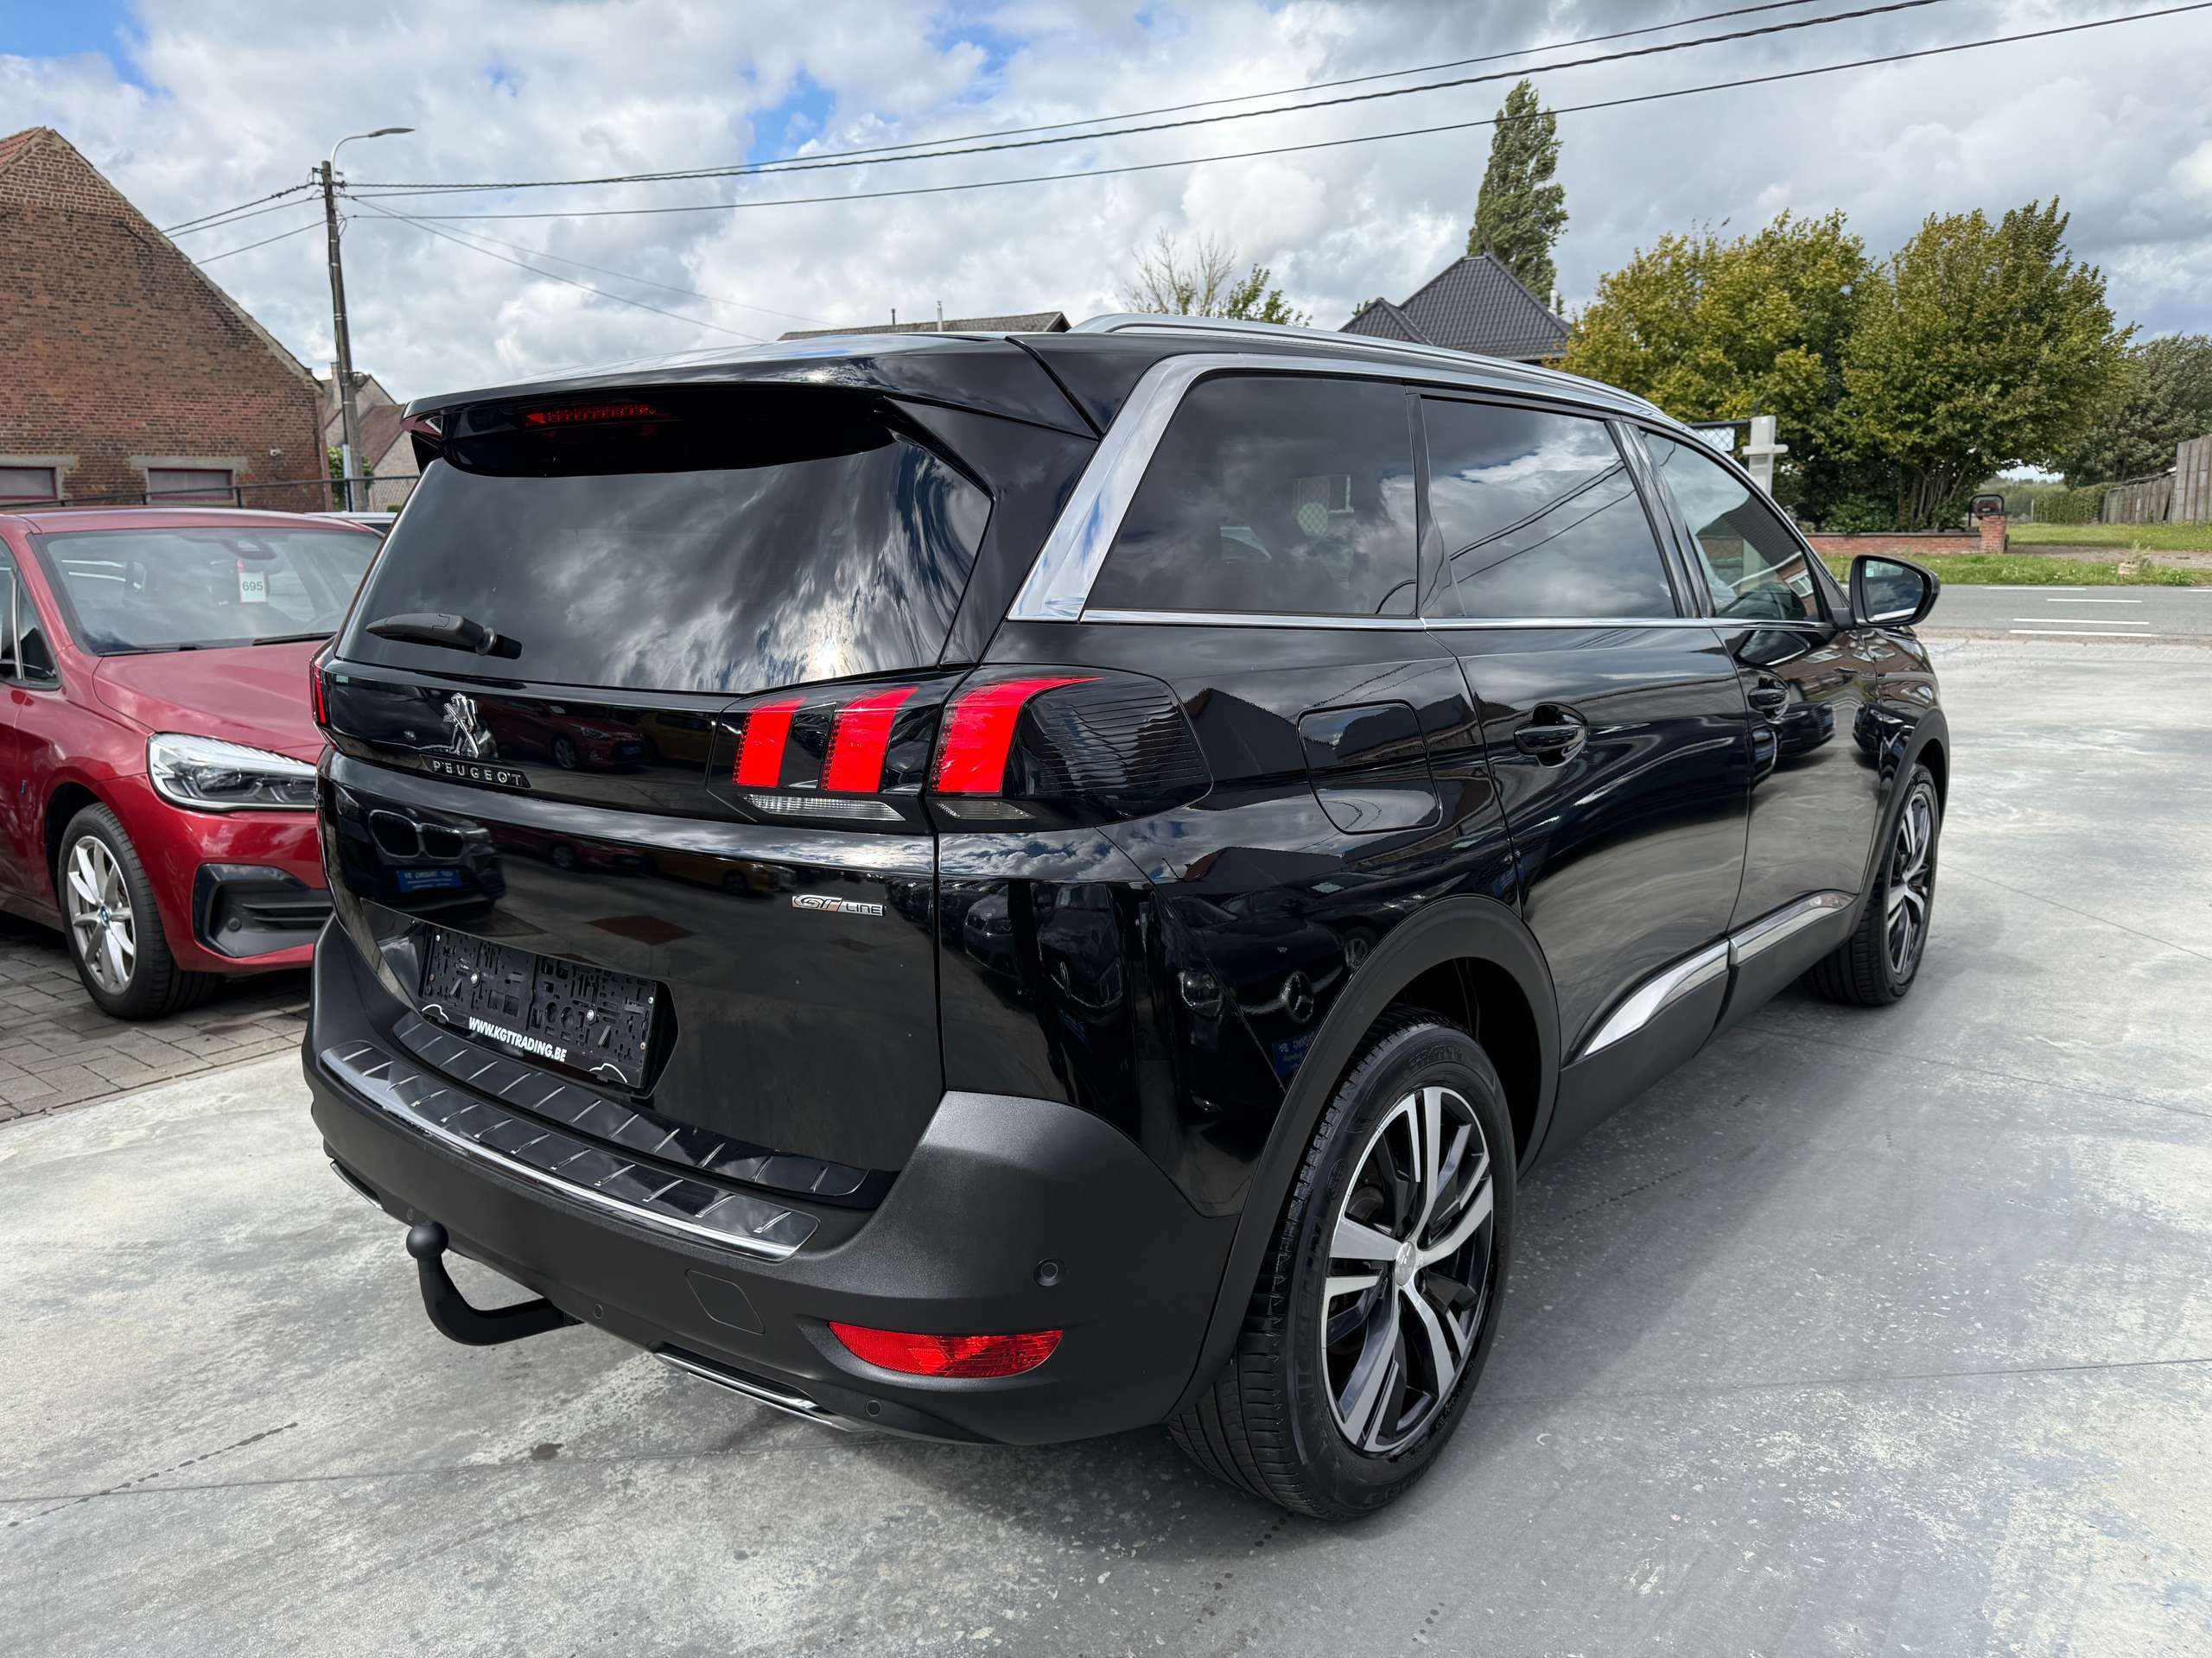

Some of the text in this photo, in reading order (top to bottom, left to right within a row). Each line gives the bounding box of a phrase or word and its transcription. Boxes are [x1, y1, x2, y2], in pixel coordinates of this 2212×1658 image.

[242, 581, 264, 592] 695
[432, 760, 522, 786] PEUGEOT
[468, 1016, 568, 1064] WWW.KGTTRADING.BE
